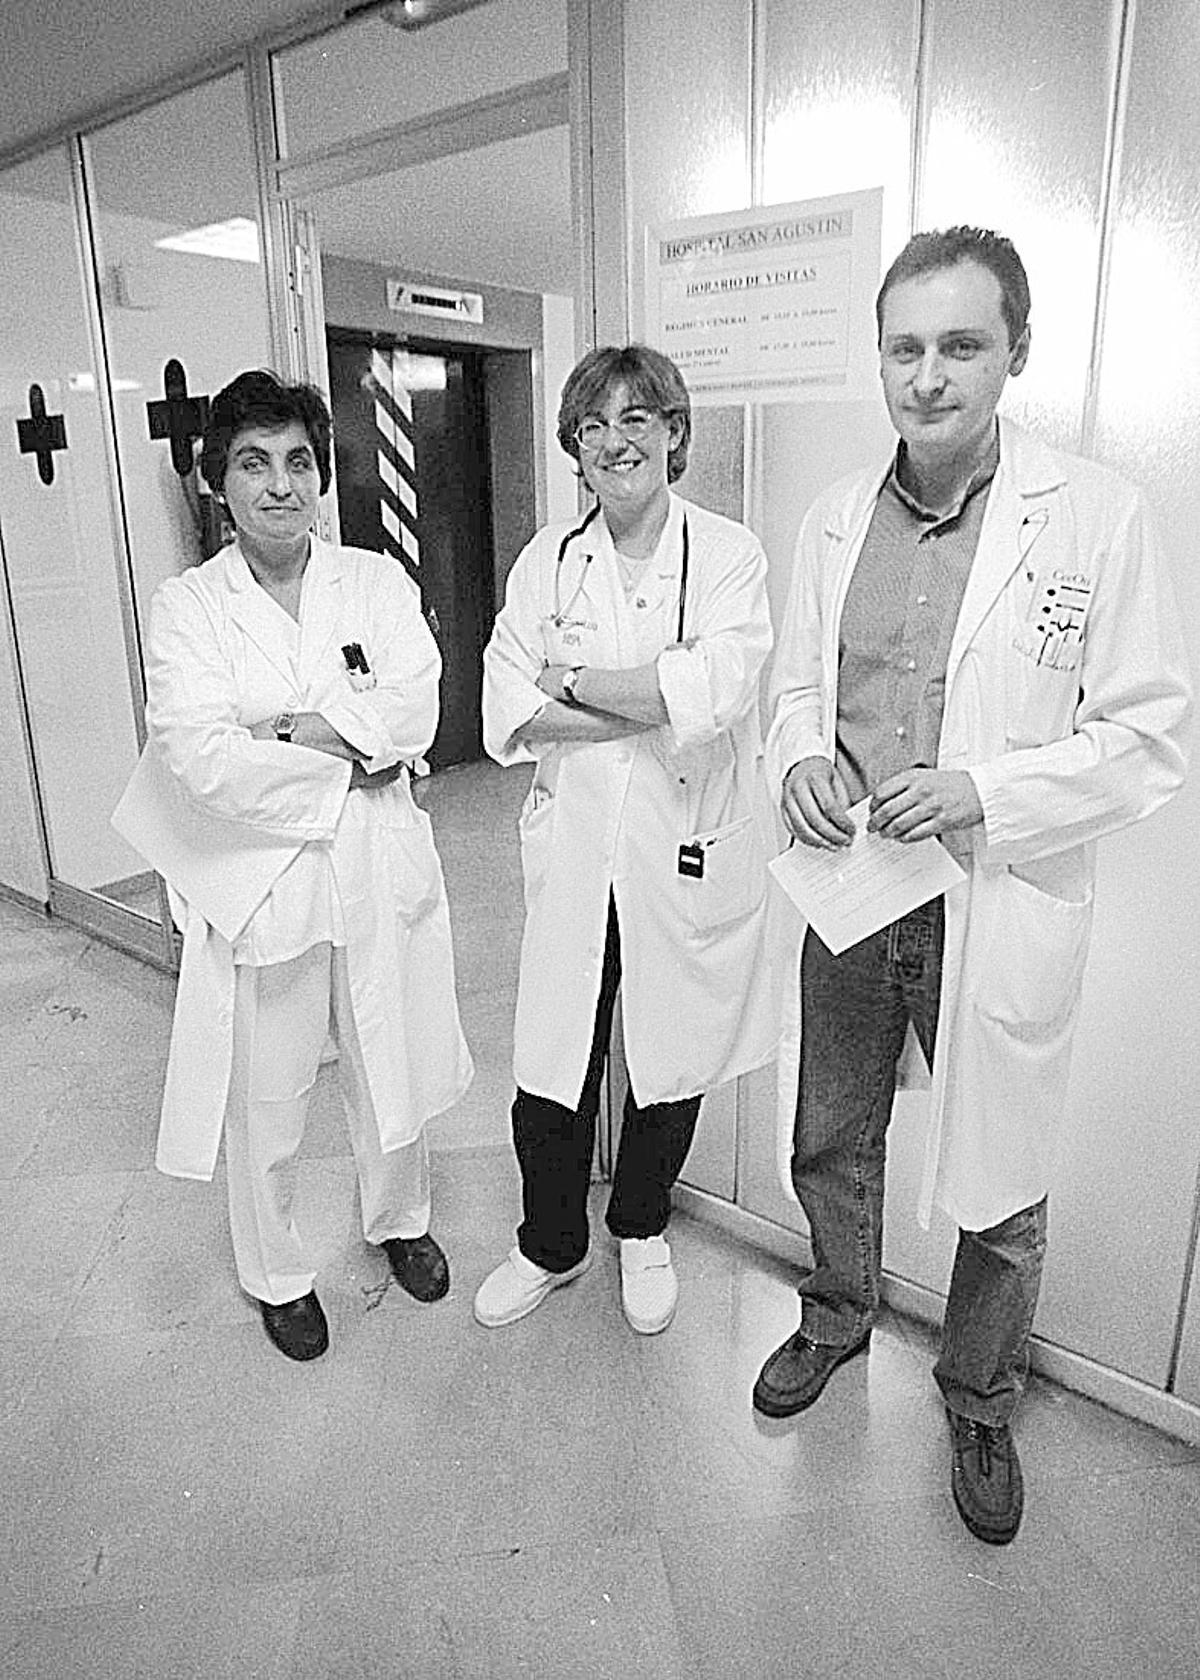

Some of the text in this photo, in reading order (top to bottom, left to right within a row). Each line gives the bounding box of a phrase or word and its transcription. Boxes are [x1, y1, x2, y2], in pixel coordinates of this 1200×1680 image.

[737, 227, 769, 249] SAN
[686, 267, 817, 294] HORARIO DE VISITAS
